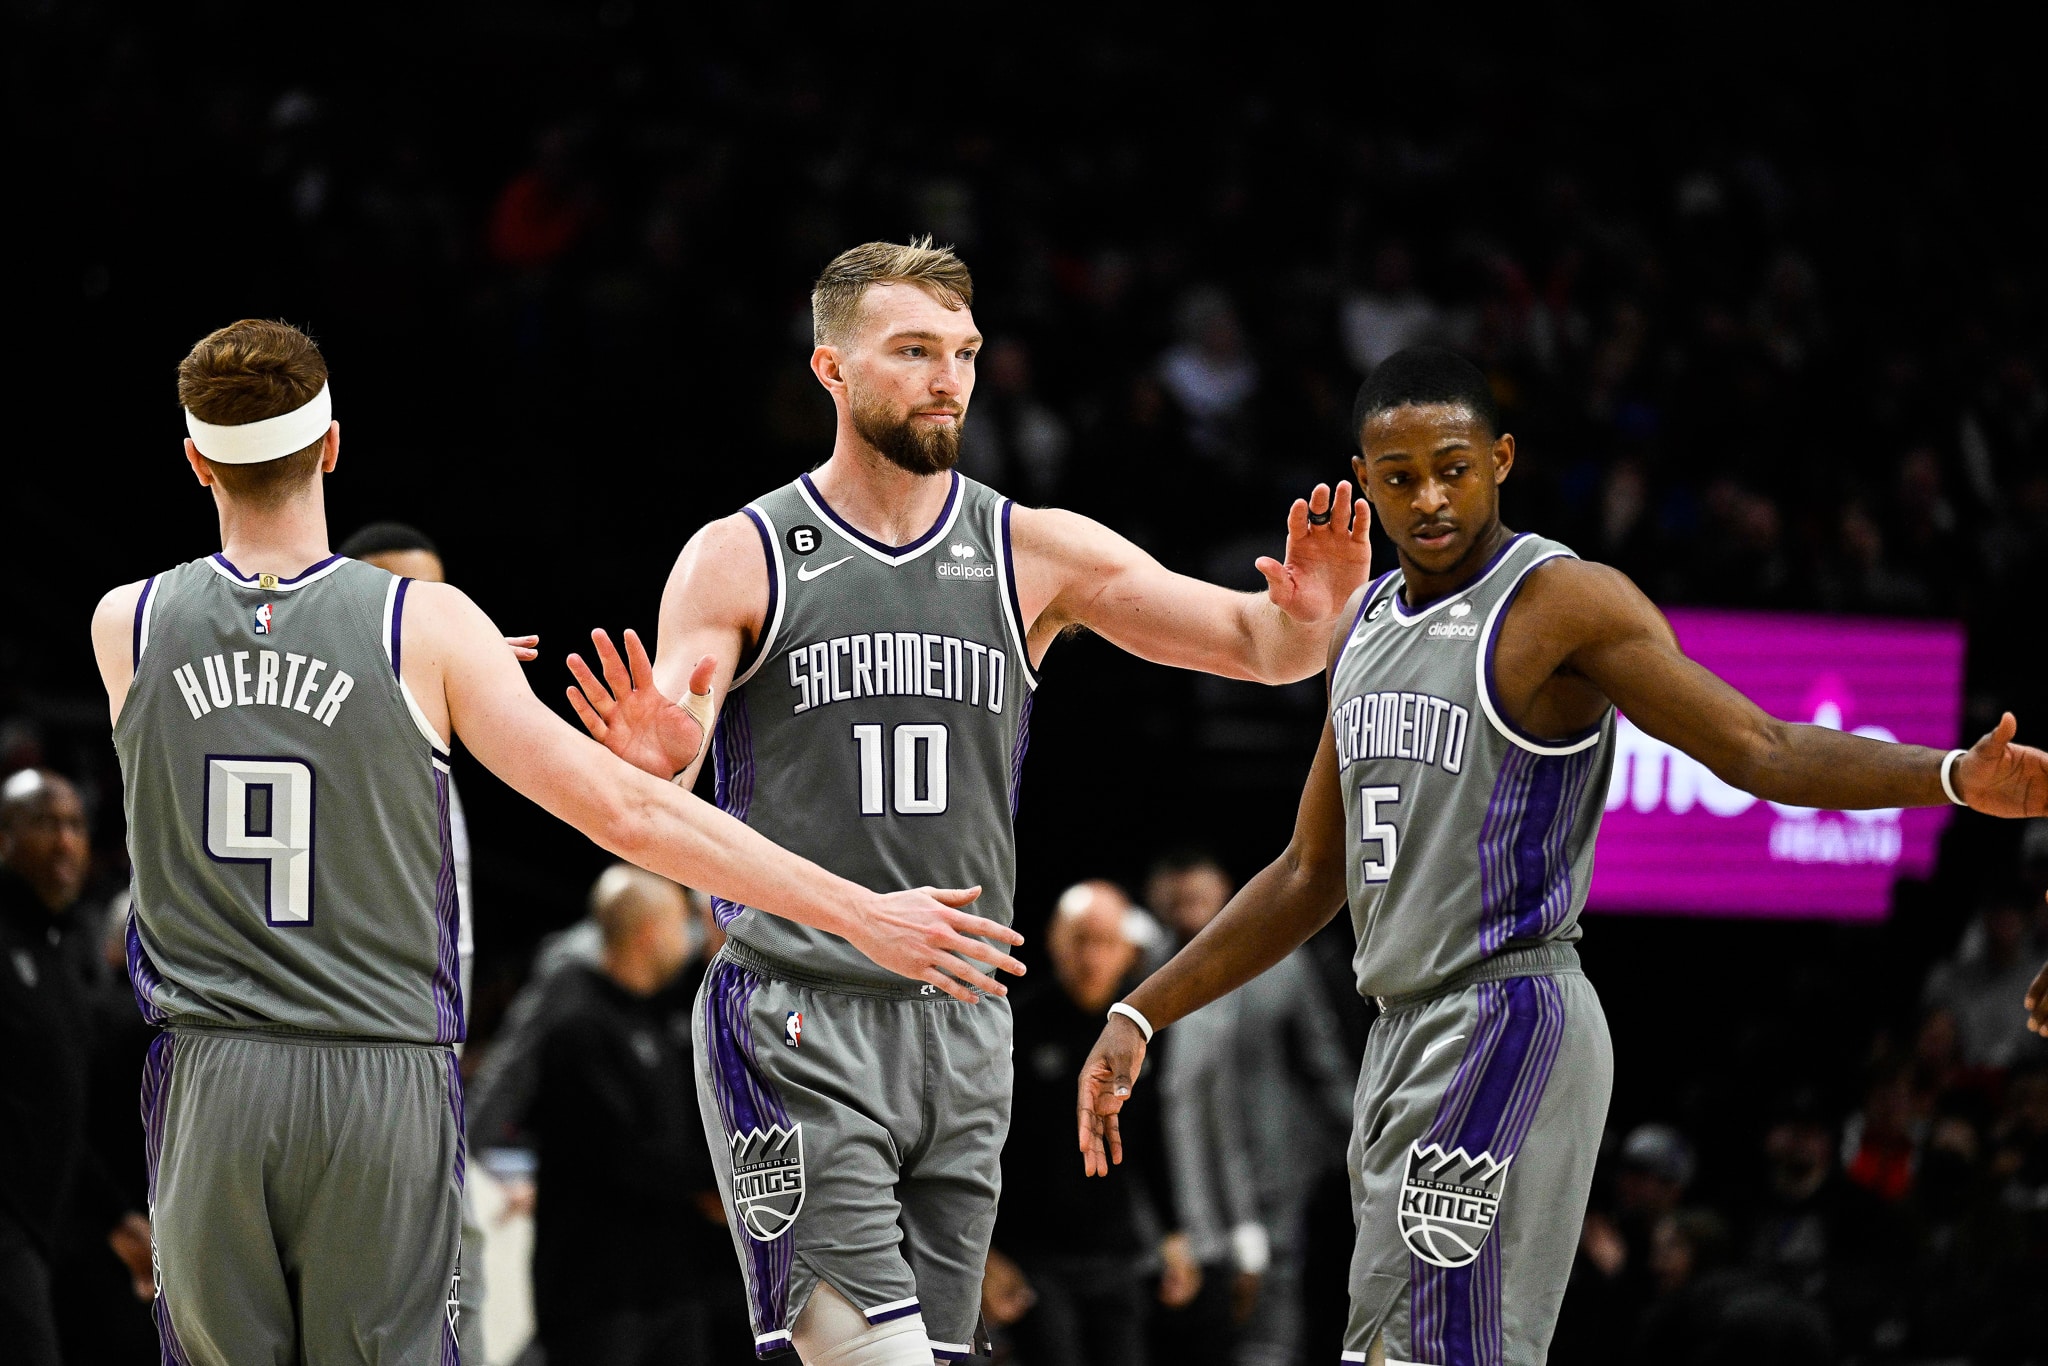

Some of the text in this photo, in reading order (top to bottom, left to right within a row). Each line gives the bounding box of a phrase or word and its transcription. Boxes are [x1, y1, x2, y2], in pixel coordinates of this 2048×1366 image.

[794, 529, 815, 552] 6
[937, 562, 995, 580] dialpad
[1428, 622, 1478, 638] dialpad
[172, 650, 355, 728] HUERTER
[788, 632, 1006, 715] SACRAMENTO
[1332, 692, 1470, 776] ACRAMENTO
[851, 722, 950, 817] 10
[202, 754, 317, 928] 9
[1359, 783, 1400, 885] 5
[733, 1157, 798, 1175] SACRAMENTO
[735, 1168, 801, 1201] KINGS
[1401, 1188, 1497, 1227] KINGS
[1408, 1177, 1499, 1199] SACRAMENTO
